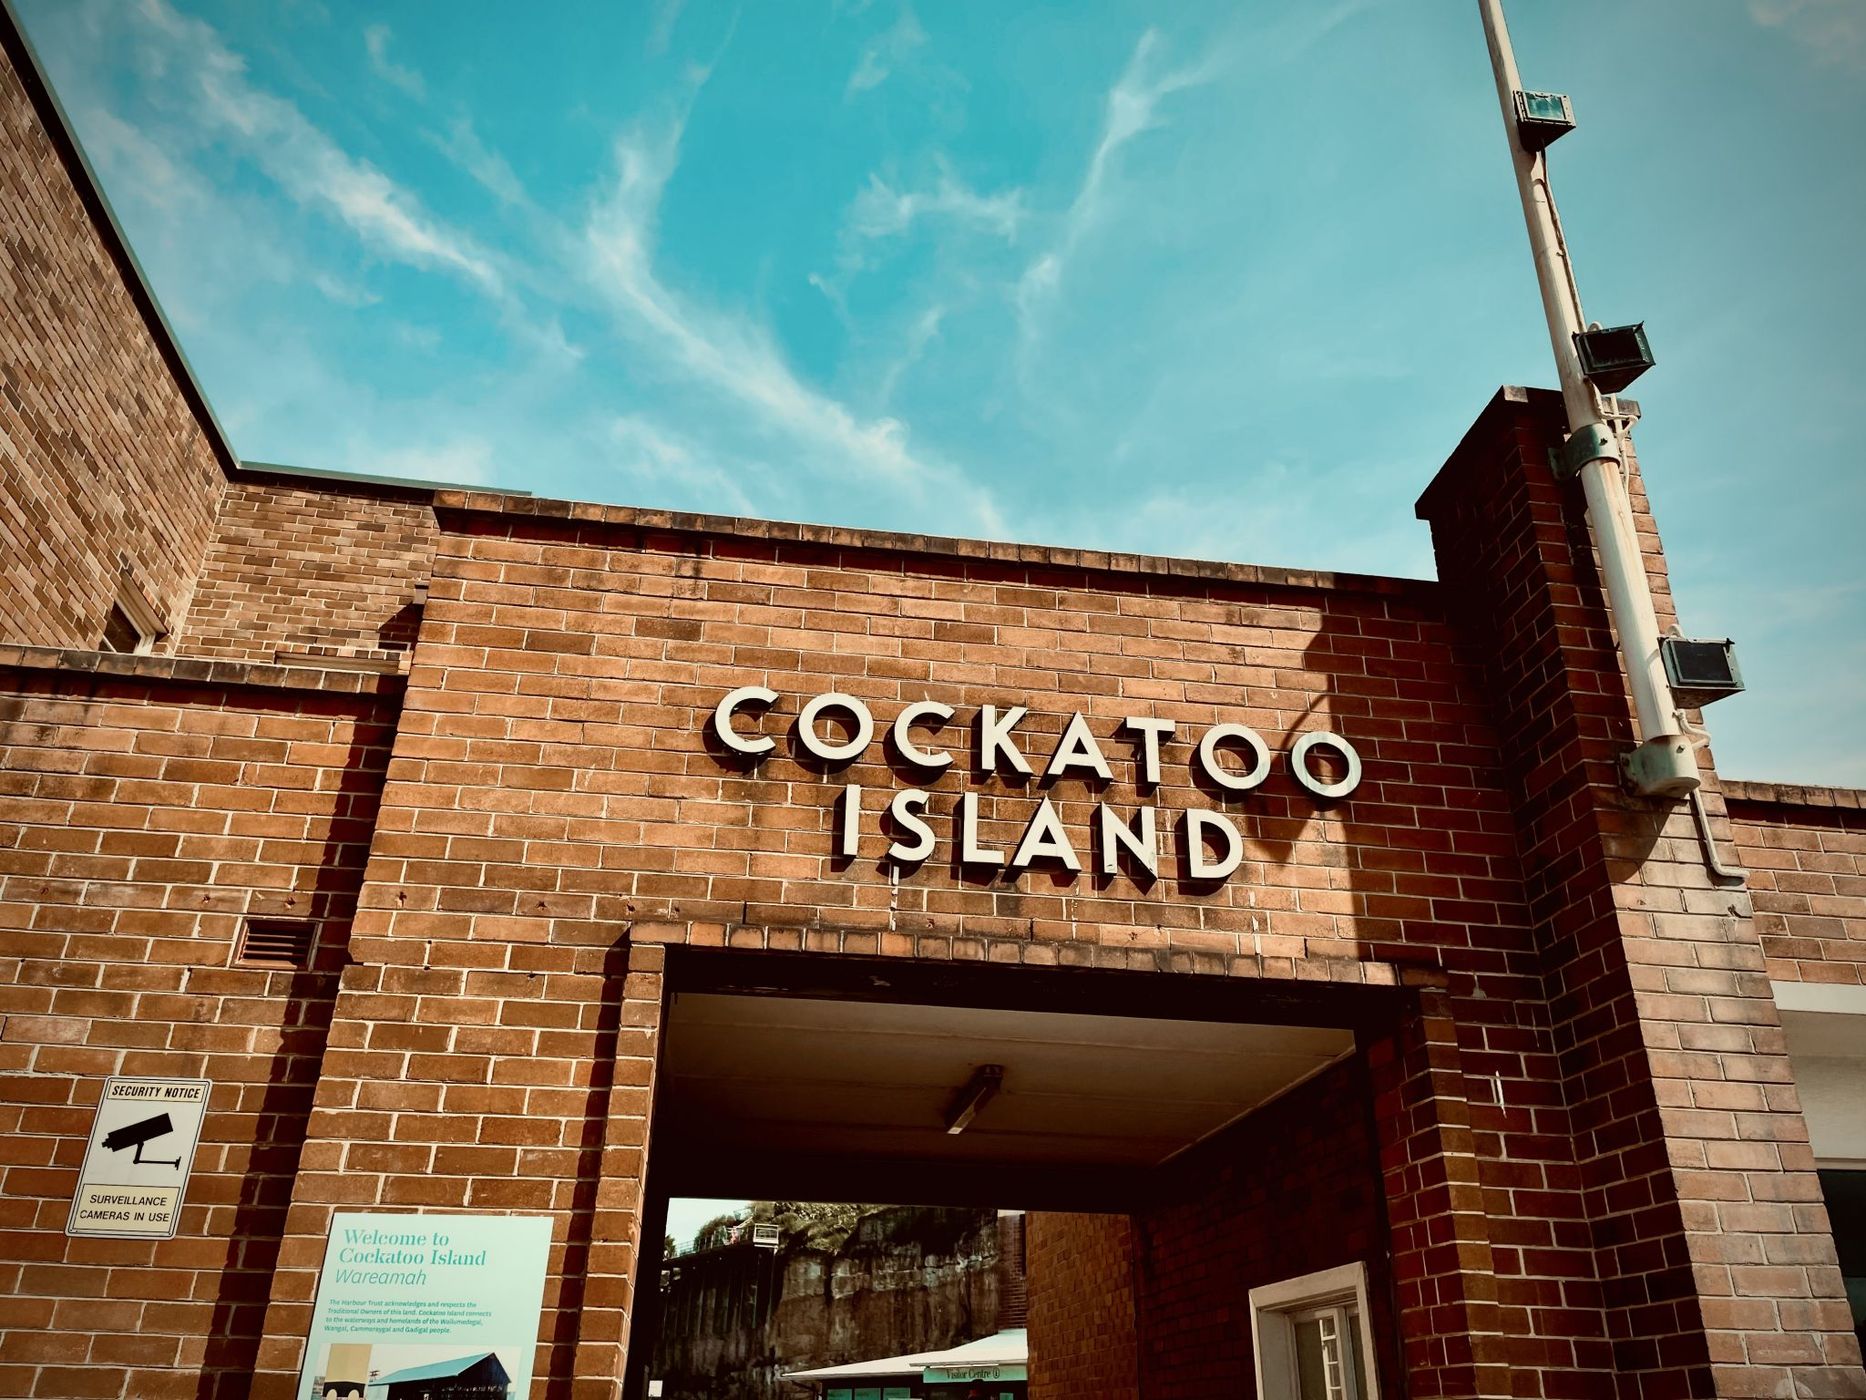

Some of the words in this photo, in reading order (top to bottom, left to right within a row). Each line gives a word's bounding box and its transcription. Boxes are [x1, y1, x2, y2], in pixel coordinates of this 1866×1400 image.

[714, 686, 1363, 798] COCKATOO
[843, 784, 1245, 880] ISLAND
[112, 1085, 161, 1097] SECURITY
[164, 1087, 201, 1099] NOTICE
[89, 1194, 168, 1206] SURVEILLANCE
[79, 1209, 130, 1221] CAMERAS
[133, 1212, 145, 1221] IN
[148, 1212, 170, 1222] USE
[344, 1229, 427, 1246] Welcome
[432, 1232, 449, 1246] to
[339, 1247, 424, 1265] Cockatoo
[430, 1249, 487, 1266] Island
[335, 1268, 427, 1285] Wareamah
[384, 1301, 426, 1309] acknowledges
[946, 1368, 968, 1379] Visitor
[968, 1368, 991, 1379] Centre
